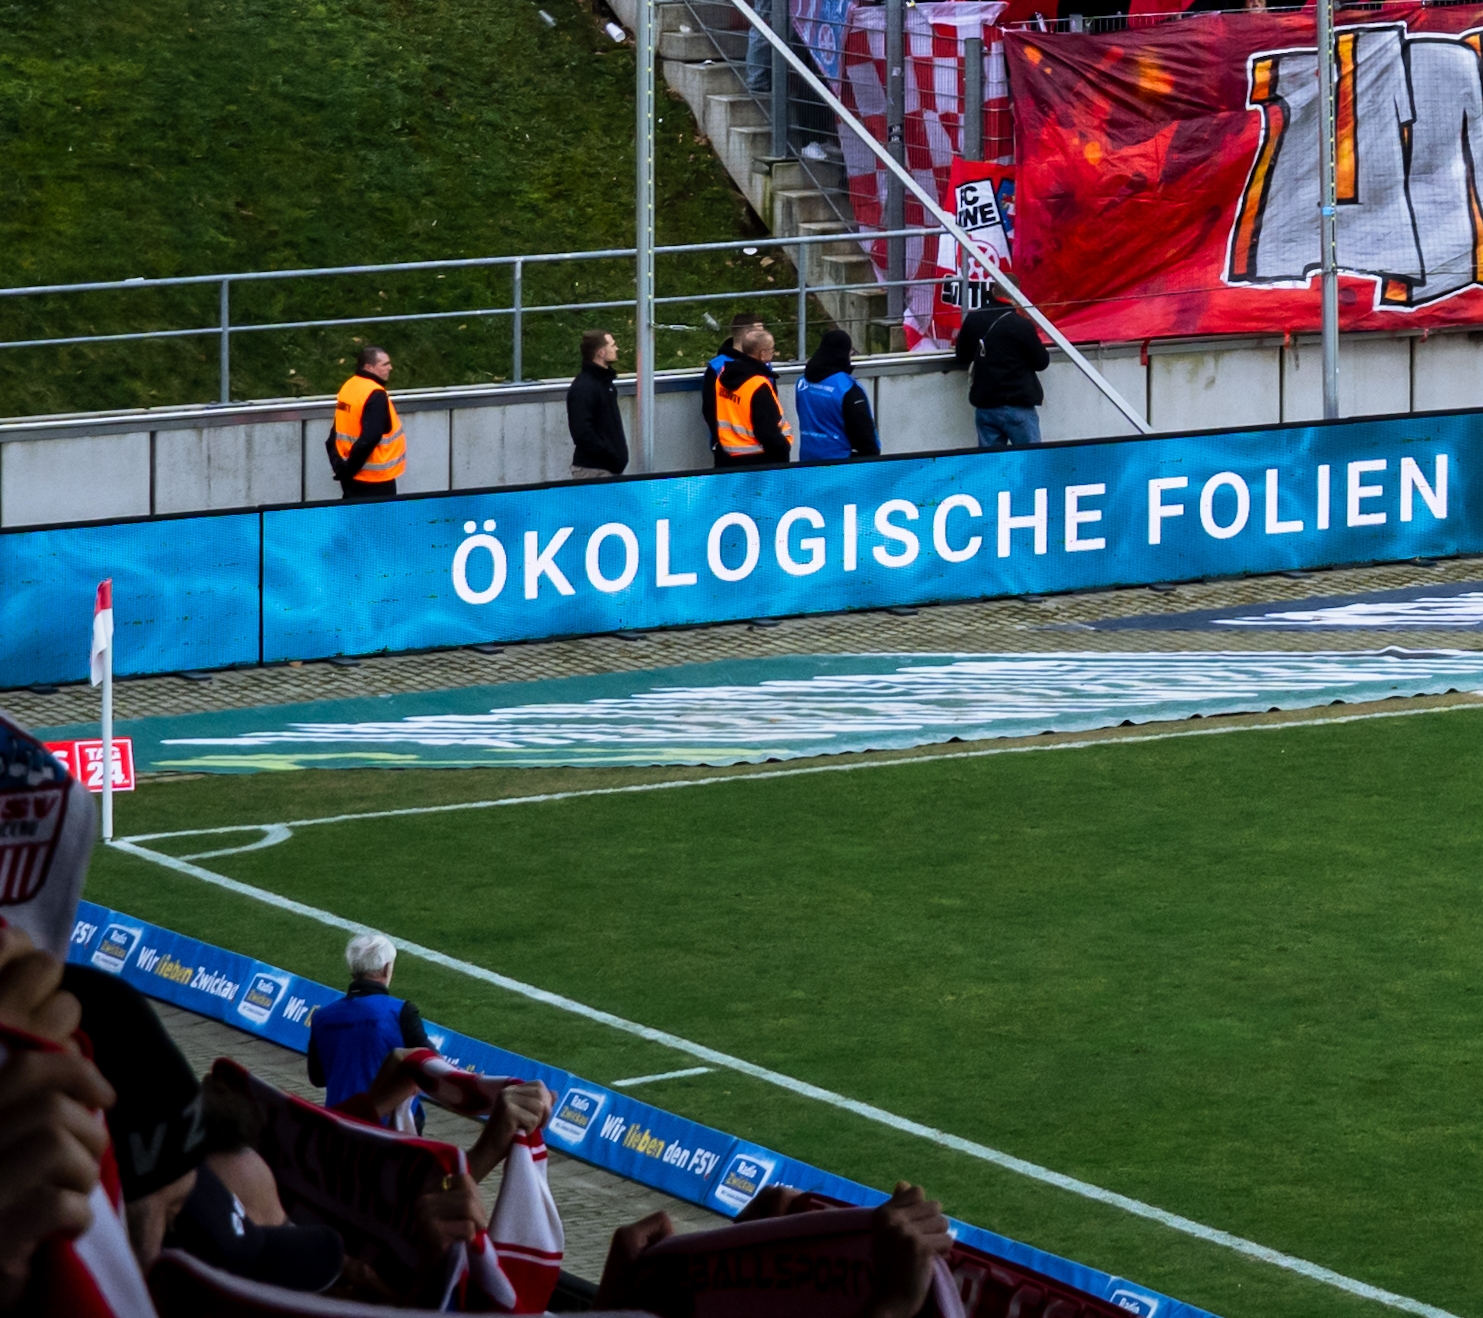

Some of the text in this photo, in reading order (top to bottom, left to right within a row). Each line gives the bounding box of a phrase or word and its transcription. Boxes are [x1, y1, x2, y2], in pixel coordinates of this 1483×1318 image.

[451, 482, 1107, 605] ÖKOLOGISCHE
[1147, 453, 1450, 546] FOLIEN
[70, 920, 98, 945] FSV
[135, 945, 160, 974] Wir
[153, 953, 195, 986] lieben
[189, 965, 241, 1003] Zwickau
[281, 995, 309, 1023] Wir
[570, 1093, 591, 1113] Radio
[600, 1113, 627, 1144] Wir
[621, 1121, 666, 1160] lieben
[662, 1138, 689, 1170] den
[686, 1146, 721, 1181] FSV
[736, 1160, 758, 1179] Radio
